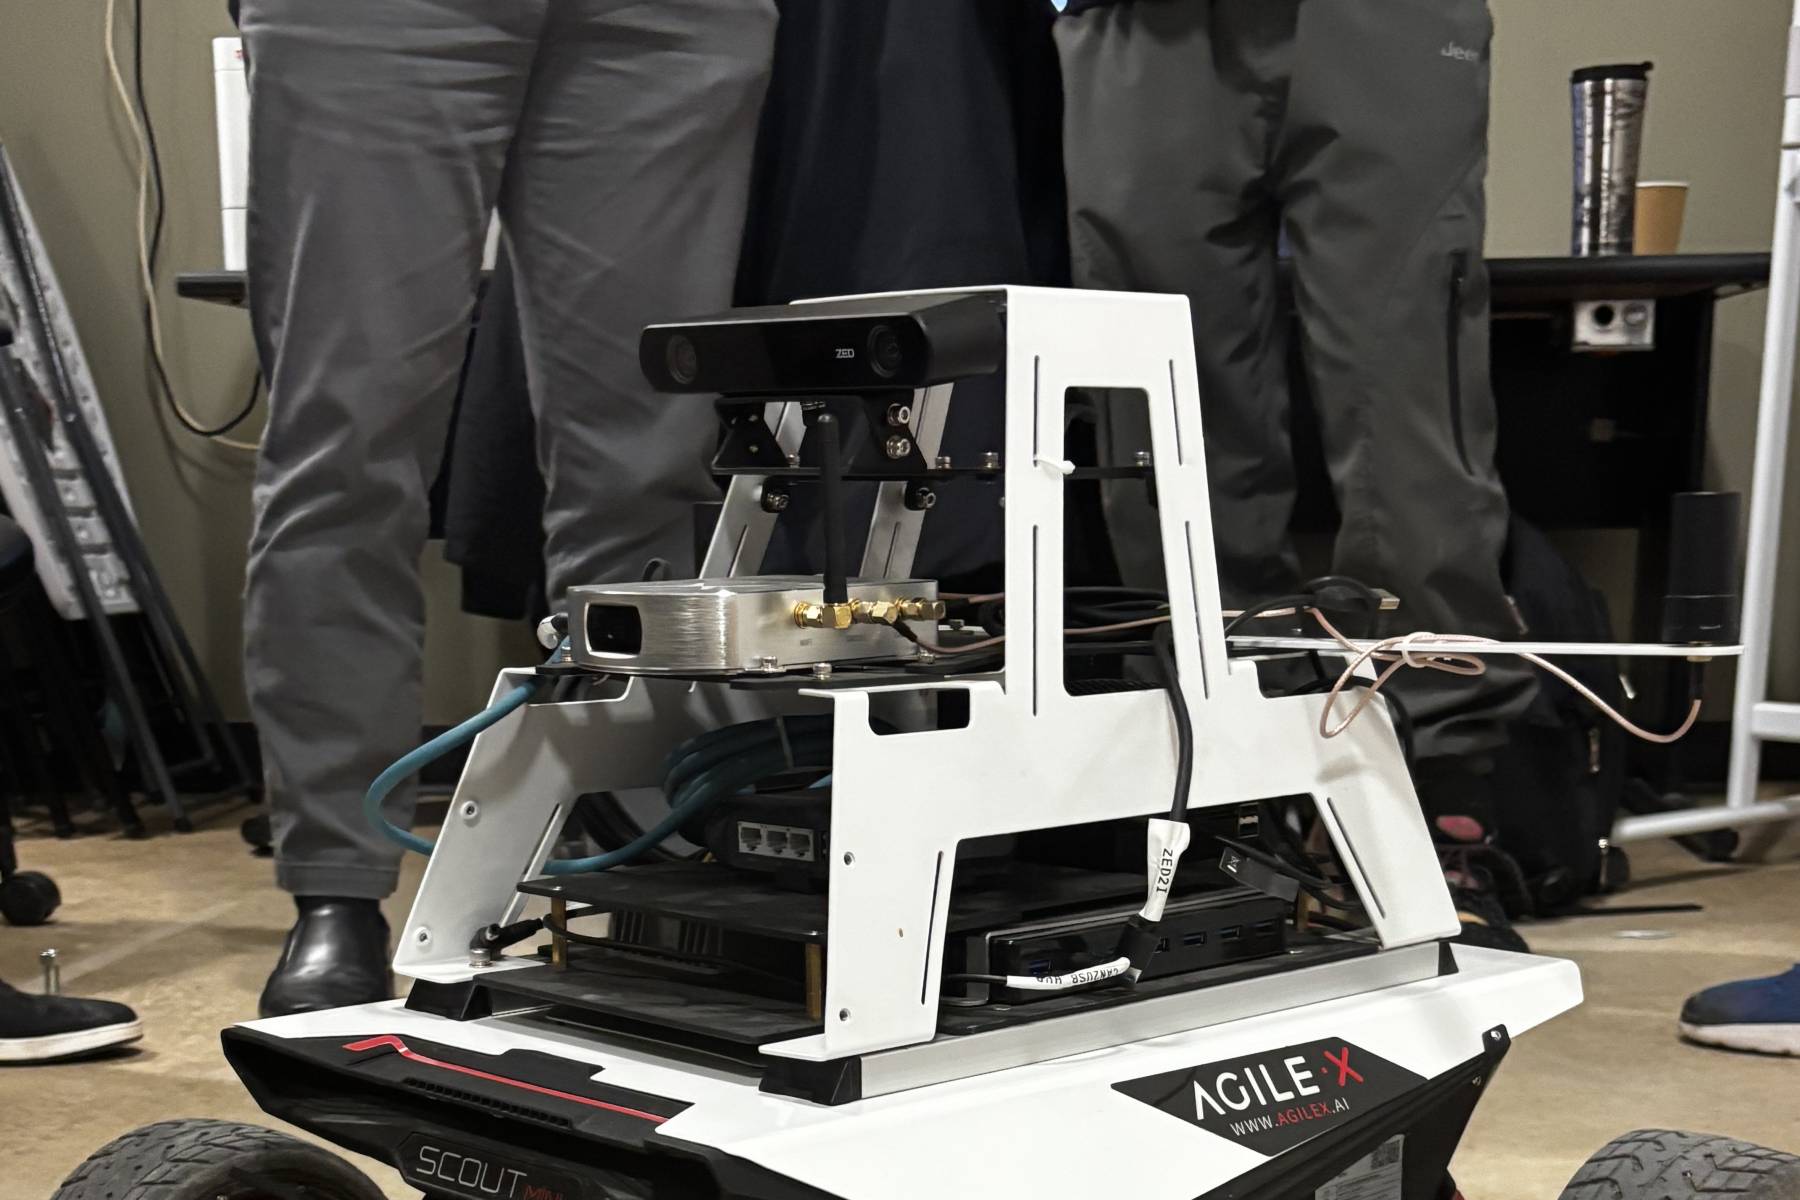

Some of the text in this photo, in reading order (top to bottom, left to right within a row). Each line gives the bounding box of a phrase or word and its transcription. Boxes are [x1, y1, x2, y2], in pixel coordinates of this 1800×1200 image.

[835, 348, 855, 359] ZED
[1156, 848, 1173, 893] ZED2I
[1229, 1097, 1350, 1136] WWW.AGILEX.AI
[416, 1145, 527, 1199] SCOUT
